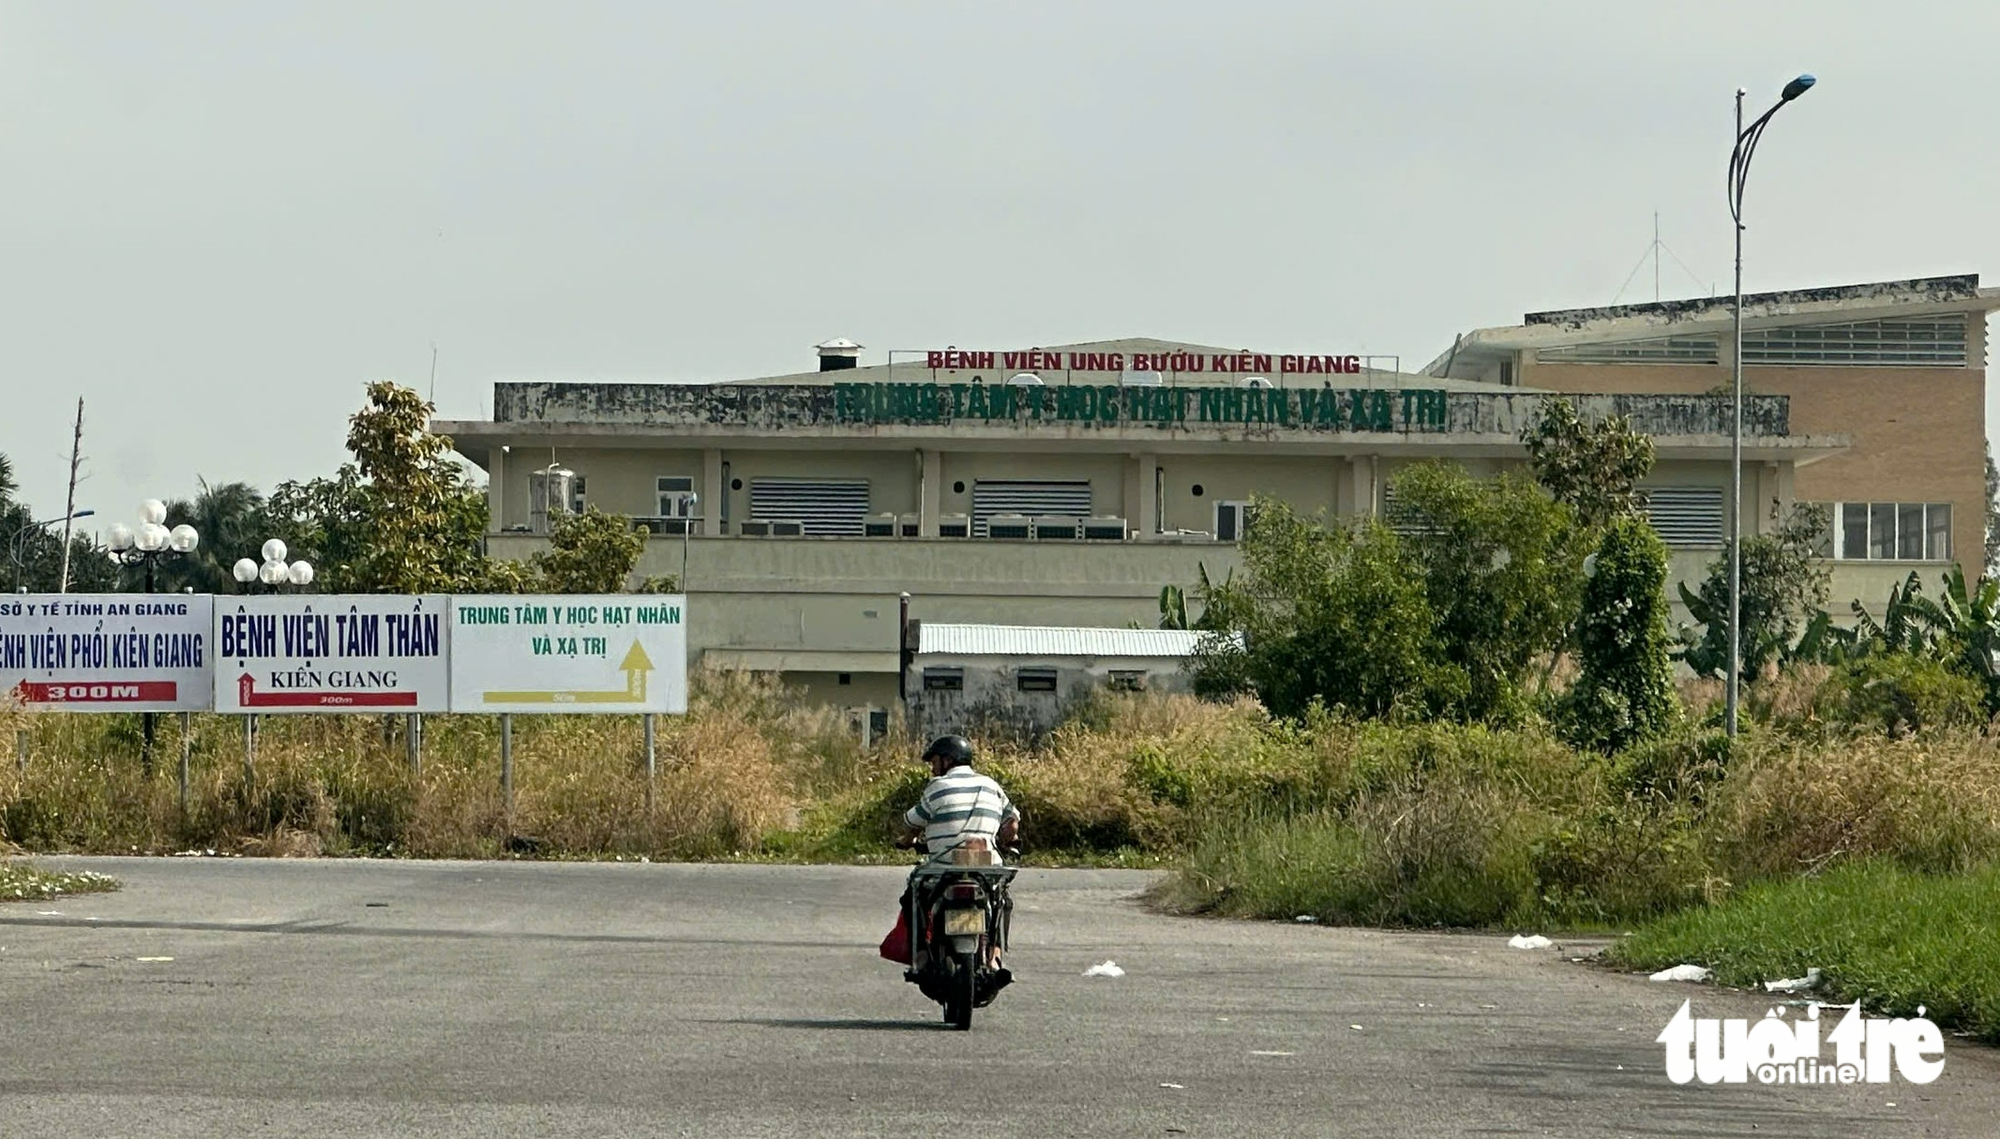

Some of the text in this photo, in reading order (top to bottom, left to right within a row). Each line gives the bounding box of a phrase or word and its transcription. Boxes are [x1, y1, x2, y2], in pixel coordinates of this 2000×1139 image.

[927, 346, 1360, 375] BỆNH VIỆN UNG BƯỚU KIÊN GIANG
[834, 382, 939, 420] TRUNG
[950, 375, 1018, 420] TÂM
[1027, 385, 1046, 420] Y
[1055, 384, 1119, 428] HỌC
[1200, 380, 1288, 424] NHÂN
[27, 604, 36, 616] Y
[41, 601, 60, 616] TẾ
[64, 600, 103, 616] TỈNH
[107, 604, 130, 616] AN
[135, 604, 187, 616] GIANG
[459, 603, 680, 629] TRUNG TÂM Y HỌC HẠT NHÂN
[221, 598, 439, 668] BỆNH VIỆN TÂM THẦN
[532, 633, 606, 659] VÀ XẠ TRỊ
[30, 626, 67, 677] VIỆN
[71, 619, 108, 669] PHỔI
[112, 626, 150, 669] KIÊN
[154, 633, 203, 669] GIANG
[271, 667, 399, 689] KIÊN GIANG
[48, 686, 139, 698] 300M
